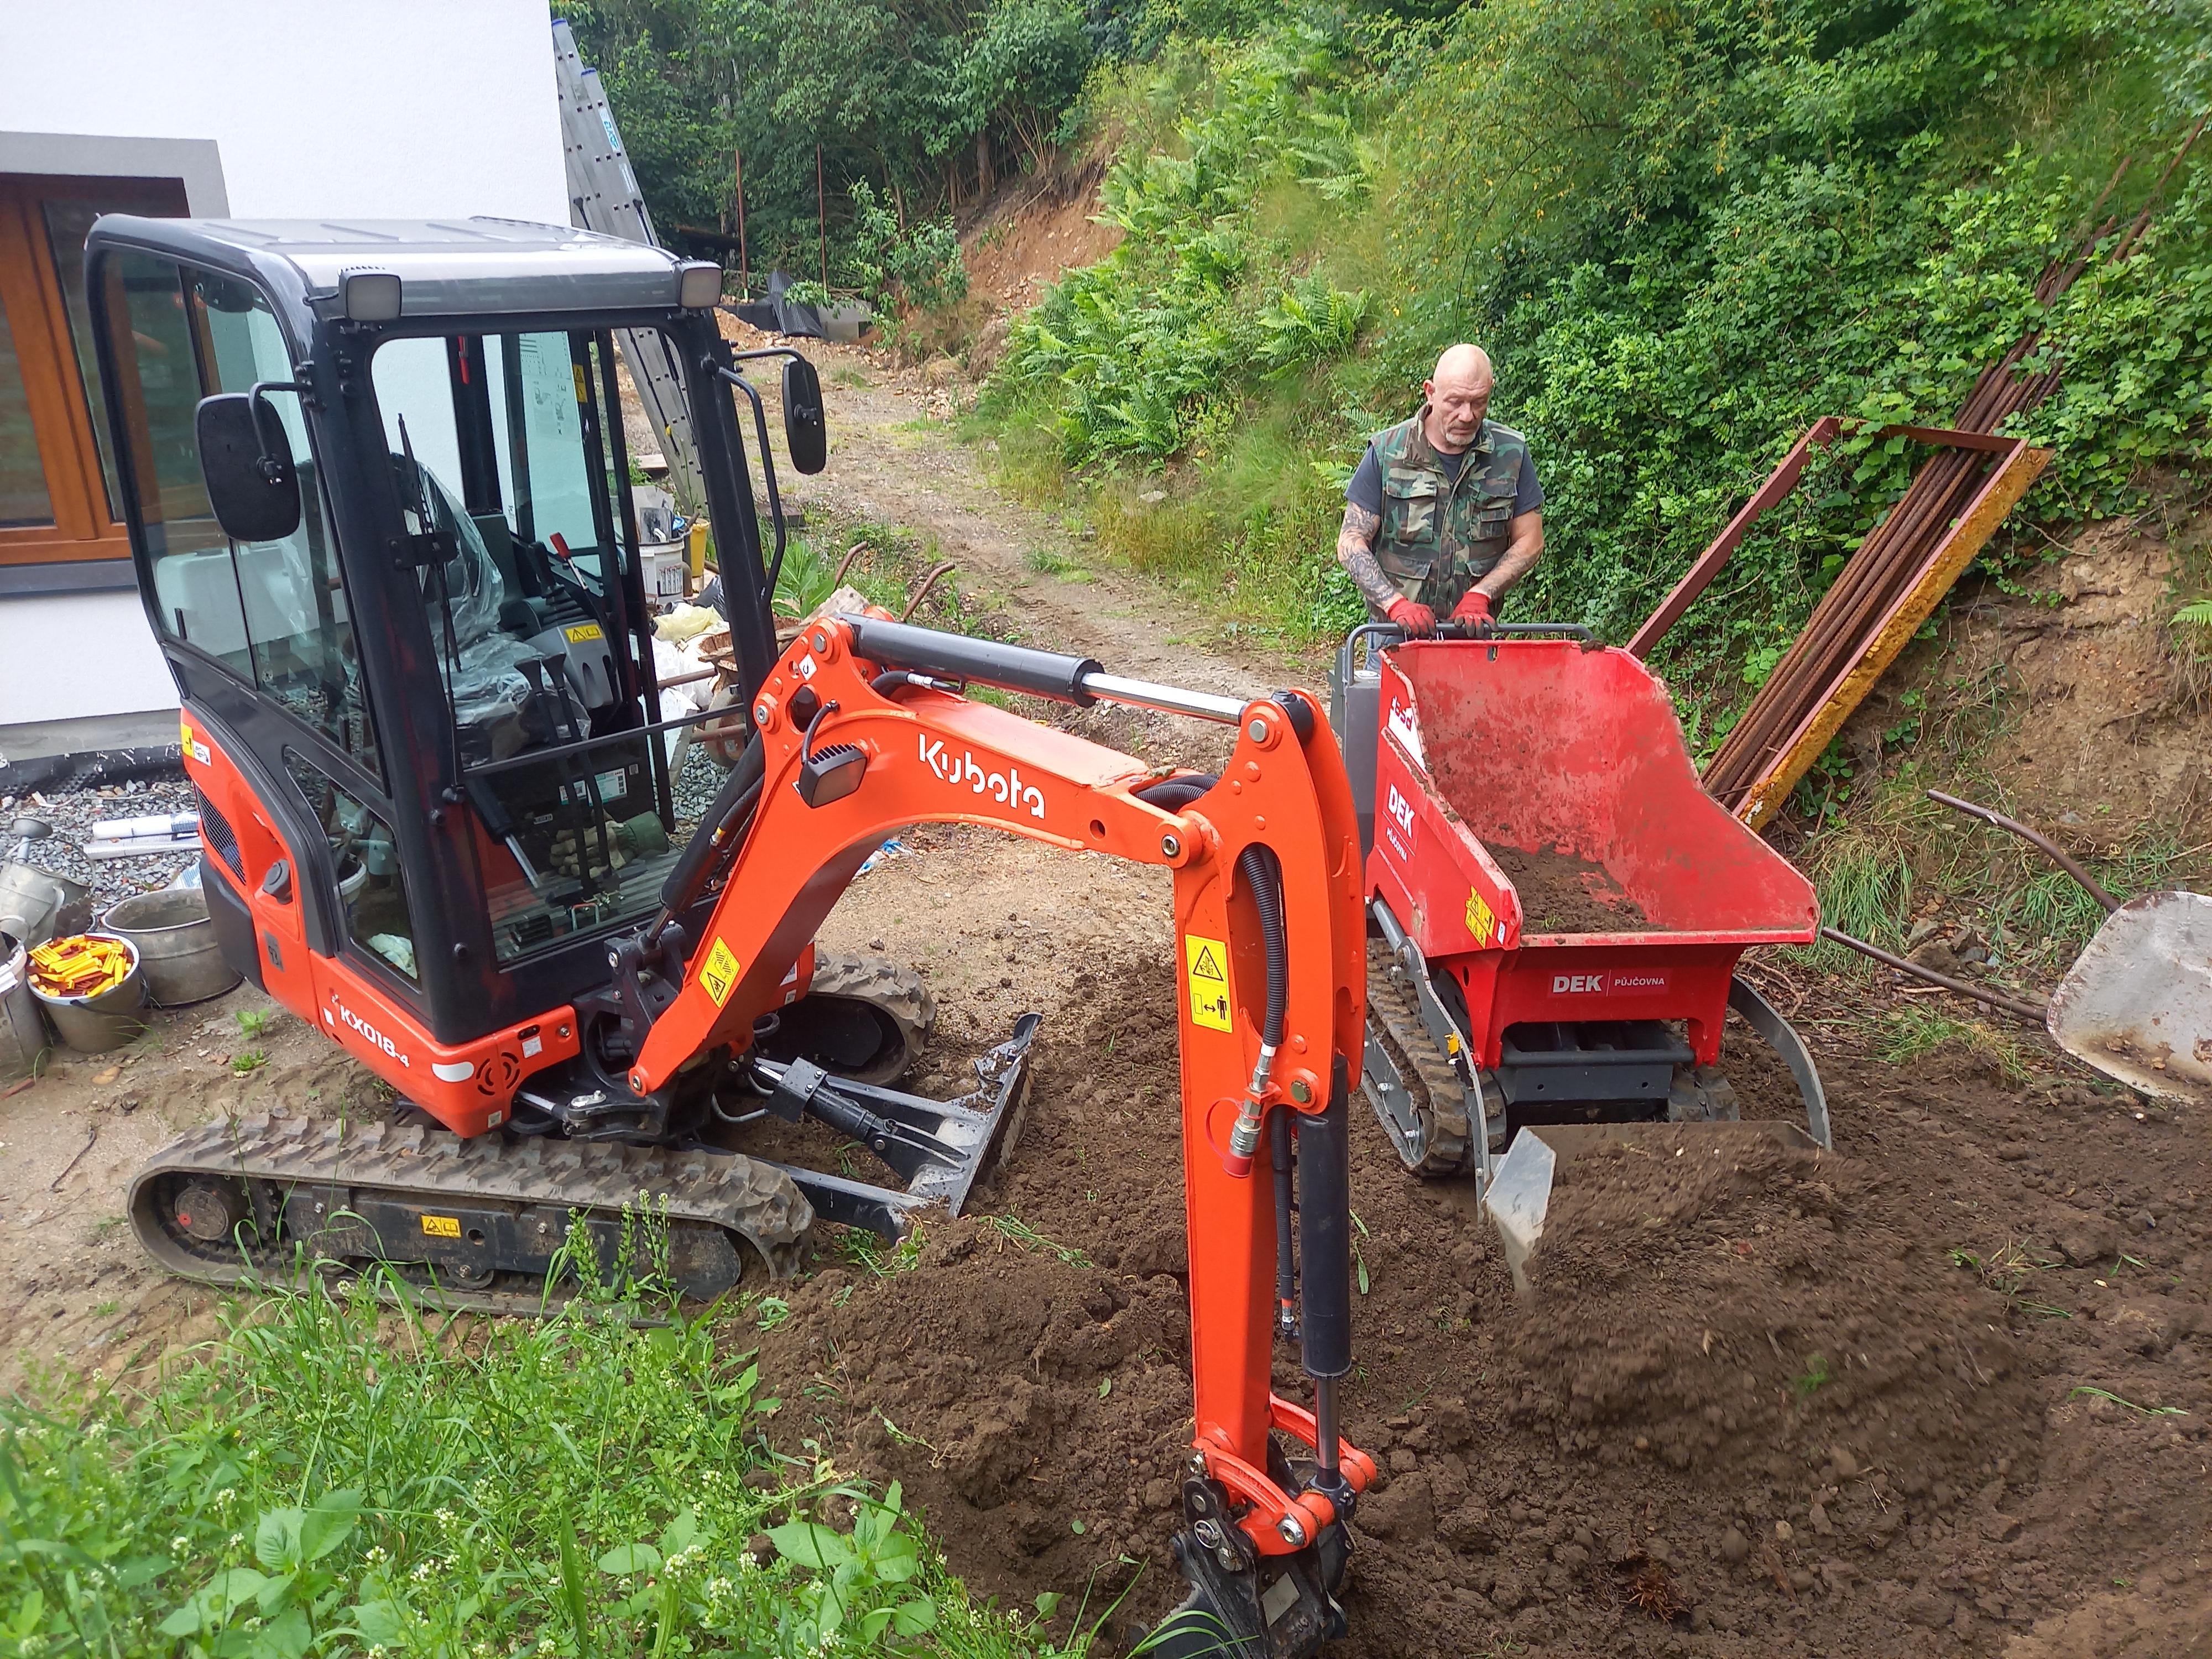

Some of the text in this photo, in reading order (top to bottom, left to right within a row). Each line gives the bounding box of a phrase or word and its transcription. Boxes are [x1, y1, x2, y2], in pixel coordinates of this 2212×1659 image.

[919, 733, 1045, 819] Kubota
[1389, 783, 1416, 839] DEK
[1553, 975, 1665, 993] DEK PŮJČOVNA
[340, 1005, 410, 1068] KX018-4
